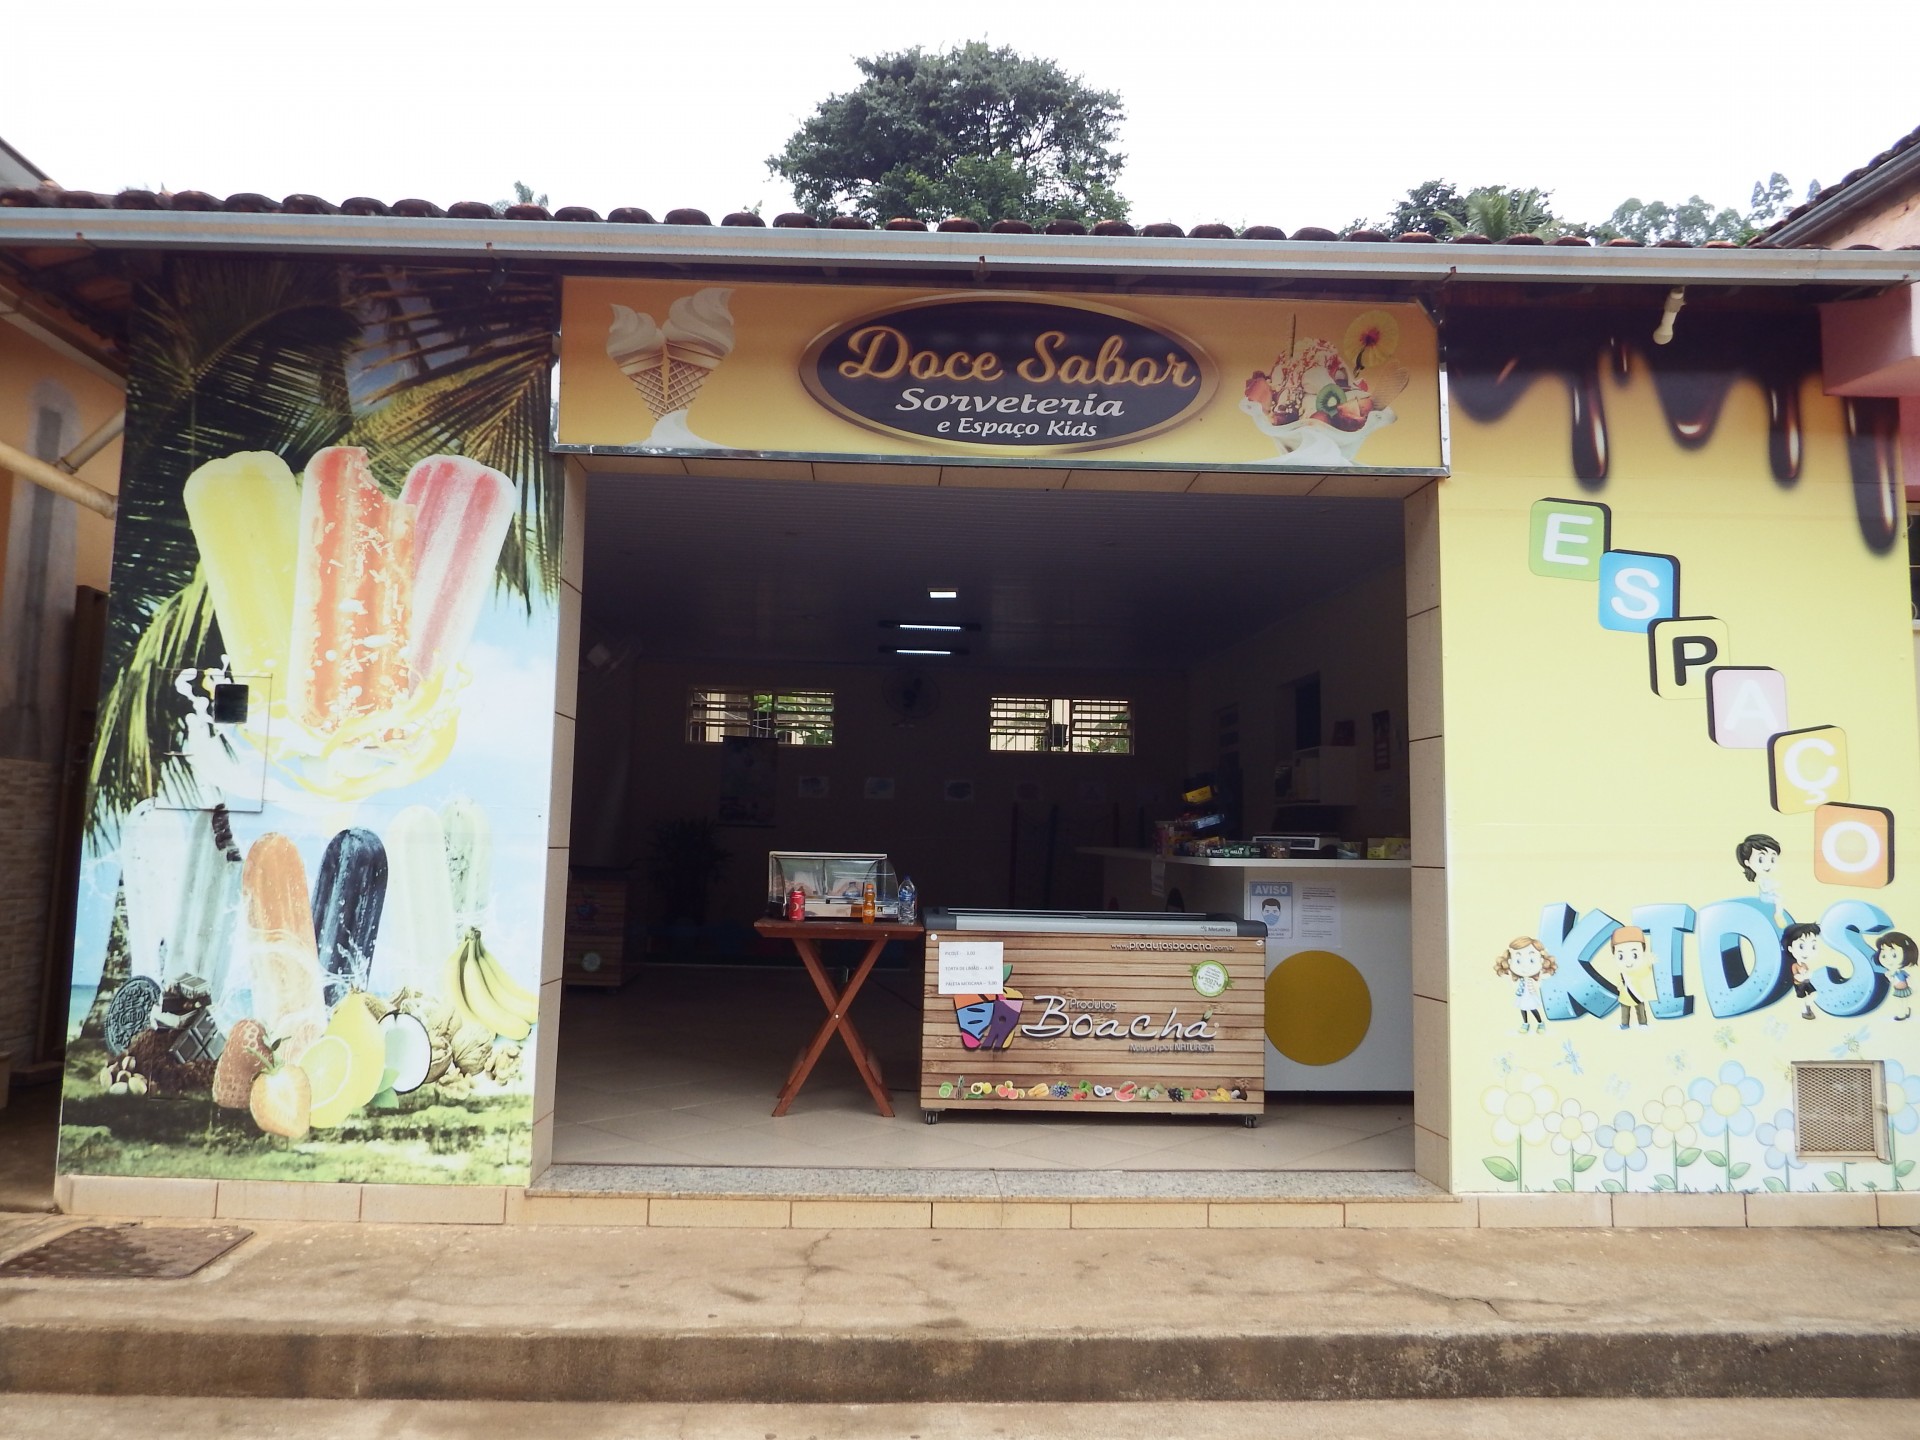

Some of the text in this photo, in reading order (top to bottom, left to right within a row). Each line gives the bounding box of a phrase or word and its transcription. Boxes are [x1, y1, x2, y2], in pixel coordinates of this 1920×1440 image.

[838, 325, 1196, 388] Doce Sabor
[895, 387, 1125, 417] Sorveteria
[936, 417, 1097, 438] e Espaço Kids
[1542, 511, 1881, 874] ESPAÇO
[1254, 885, 1288, 895] AVISO
[1536, 896, 1895, 1020] KIDS
[1068, 998, 1117, 1010] Produtos
